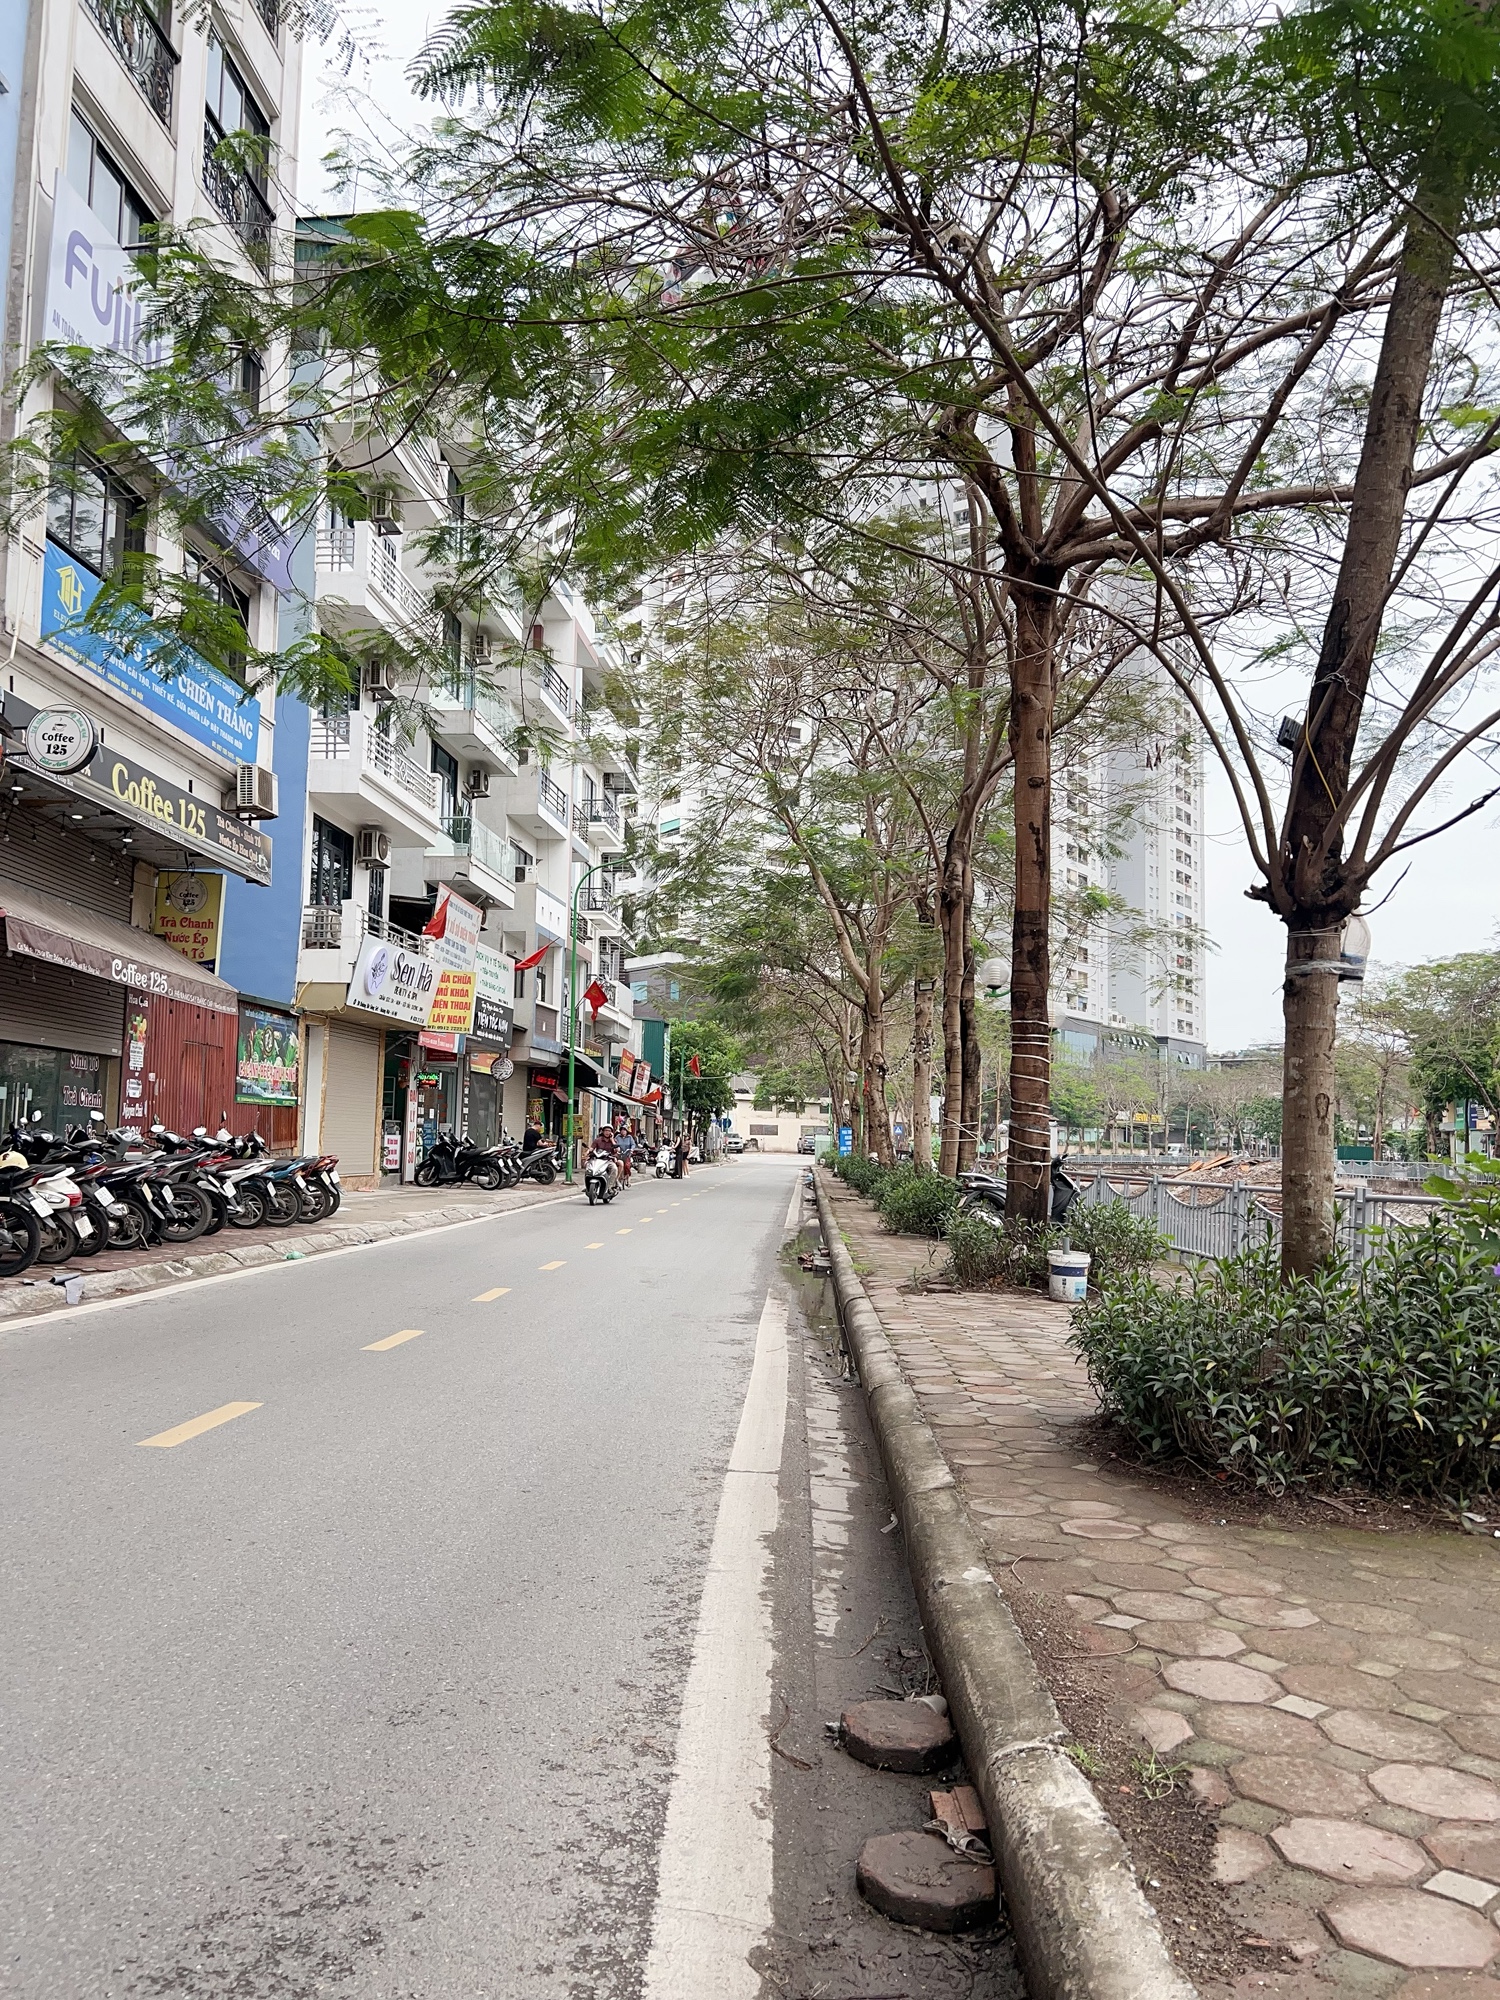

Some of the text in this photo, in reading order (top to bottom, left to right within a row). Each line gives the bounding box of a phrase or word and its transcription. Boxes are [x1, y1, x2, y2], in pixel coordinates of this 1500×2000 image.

[42, 732, 74, 743] Coffee
[46, 744, 67, 755] 125
[112, 762, 174, 824] Coffee
[179, 798, 206, 840] 125
[159, 915, 214, 930] Trà Chanh
[192, 930, 209, 946] Ép
[191, 947, 205, 959] Tố
[111, 958, 168, 993] Coffee 125
[392, 952, 416, 987] Sen
[452, 974, 471, 985] CHỮA
[436, 985, 469, 998] MỞ KHÓA
[451, 1000, 471, 1012] THOẠI
[432, 1011, 445, 1023] LẤY
[447, 1015, 467, 1025] NGAY
[63, 1085, 102, 1108] Trà Chanh
